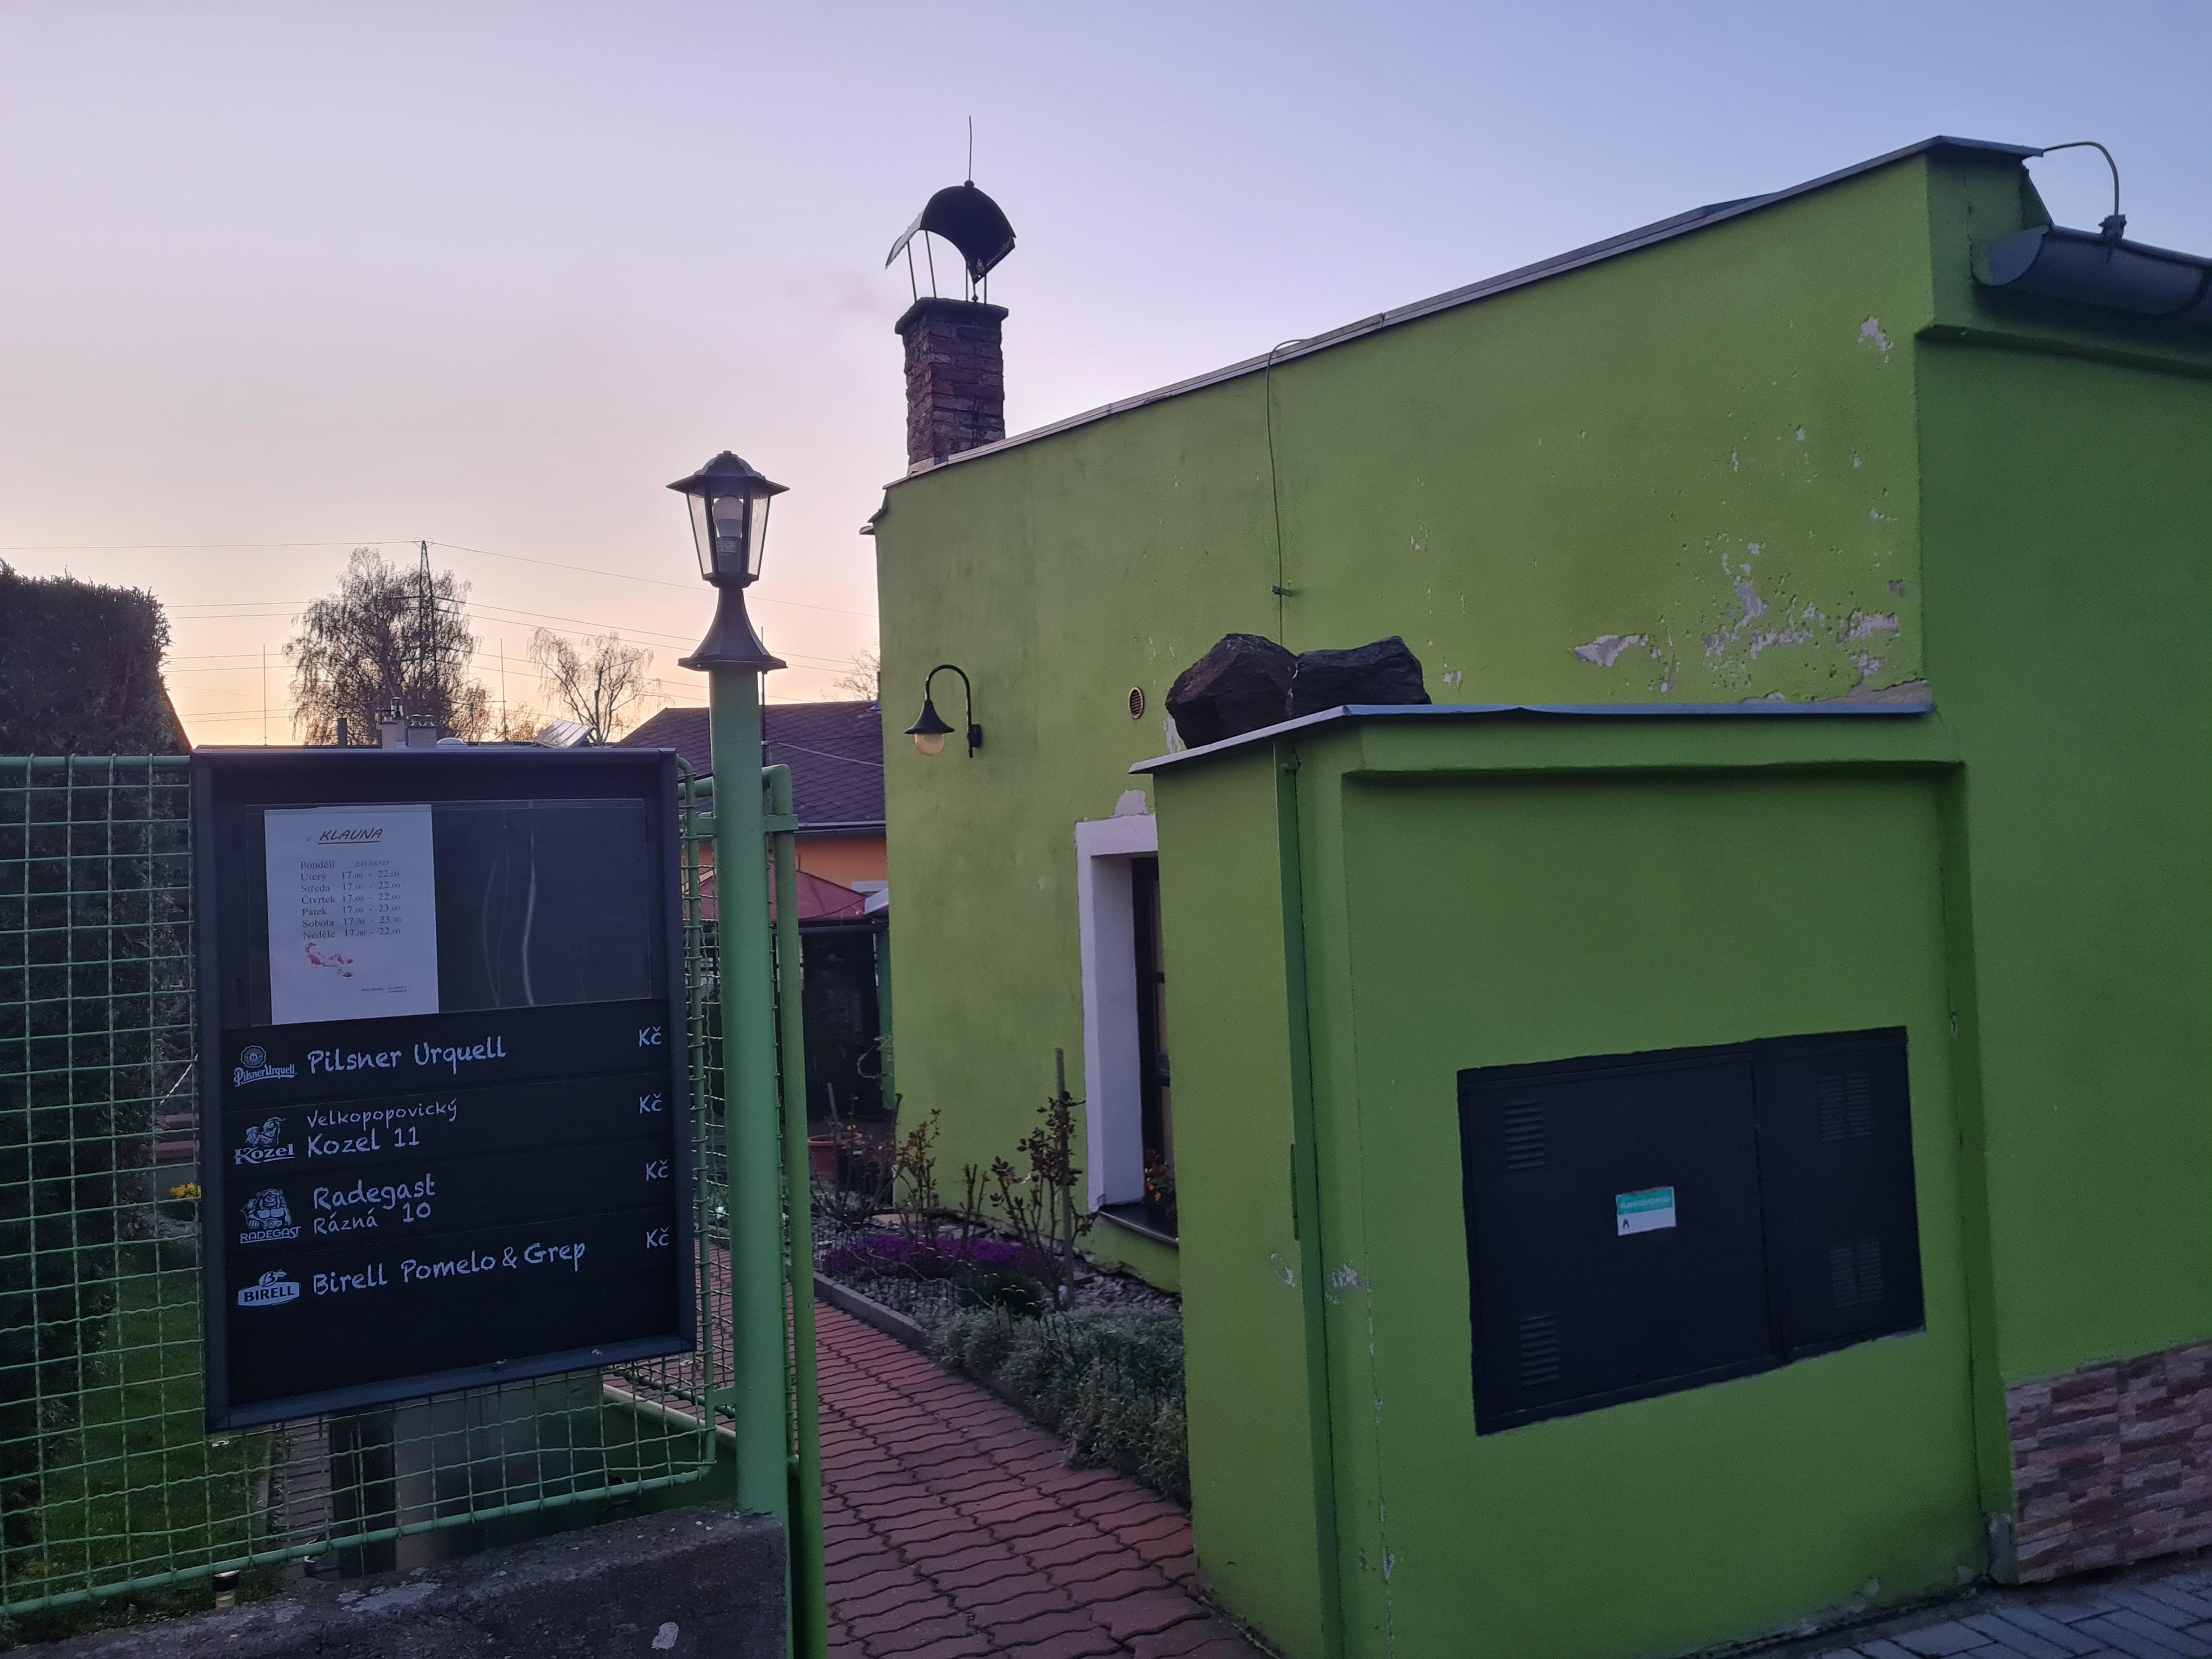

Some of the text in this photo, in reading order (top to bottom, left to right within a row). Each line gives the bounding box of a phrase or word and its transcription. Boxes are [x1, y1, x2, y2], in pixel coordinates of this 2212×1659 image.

[319, 828, 383, 841] KLAUNA
[300, 860, 335, 869] Pondělí
[301, 870, 327, 882] Úterý
[342, 871, 363, 879] 17.00
[301, 884, 331, 893] Středa
[301, 894, 336, 904] Čtvrtek
[302, 907, 327, 916] Pátek
[302, 920, 334, 928] Sobota
[303, 931, 335, 939] Neděle
[638, 1026, 662, 1047] Kč
[307, 1036, 507, 1075] Pilsner Urquell
[233, 1063, 295, 1087] Pilsner Urquell
[639, 1092, 662, 1114] Kč
[306, 1099, 458, 1129] Velkopopovický
[307, 1126, 420, 1158] Kozel 11
[234, 1143, 295, 1165] Kozel
[645, 1159, 669, 1180] Kč
[313, 1173, 436, 1211] Radegast
[314, 1202, 431, 1235] Rázná 10
[240, 1226, 301, 1244] RADEGAST
[646, 1228, 670, 1249] Kč
[312, 1241, 586, 1295] Birell Pomelo & Grep
[244, 1285, 295, 1302] BIRELL
